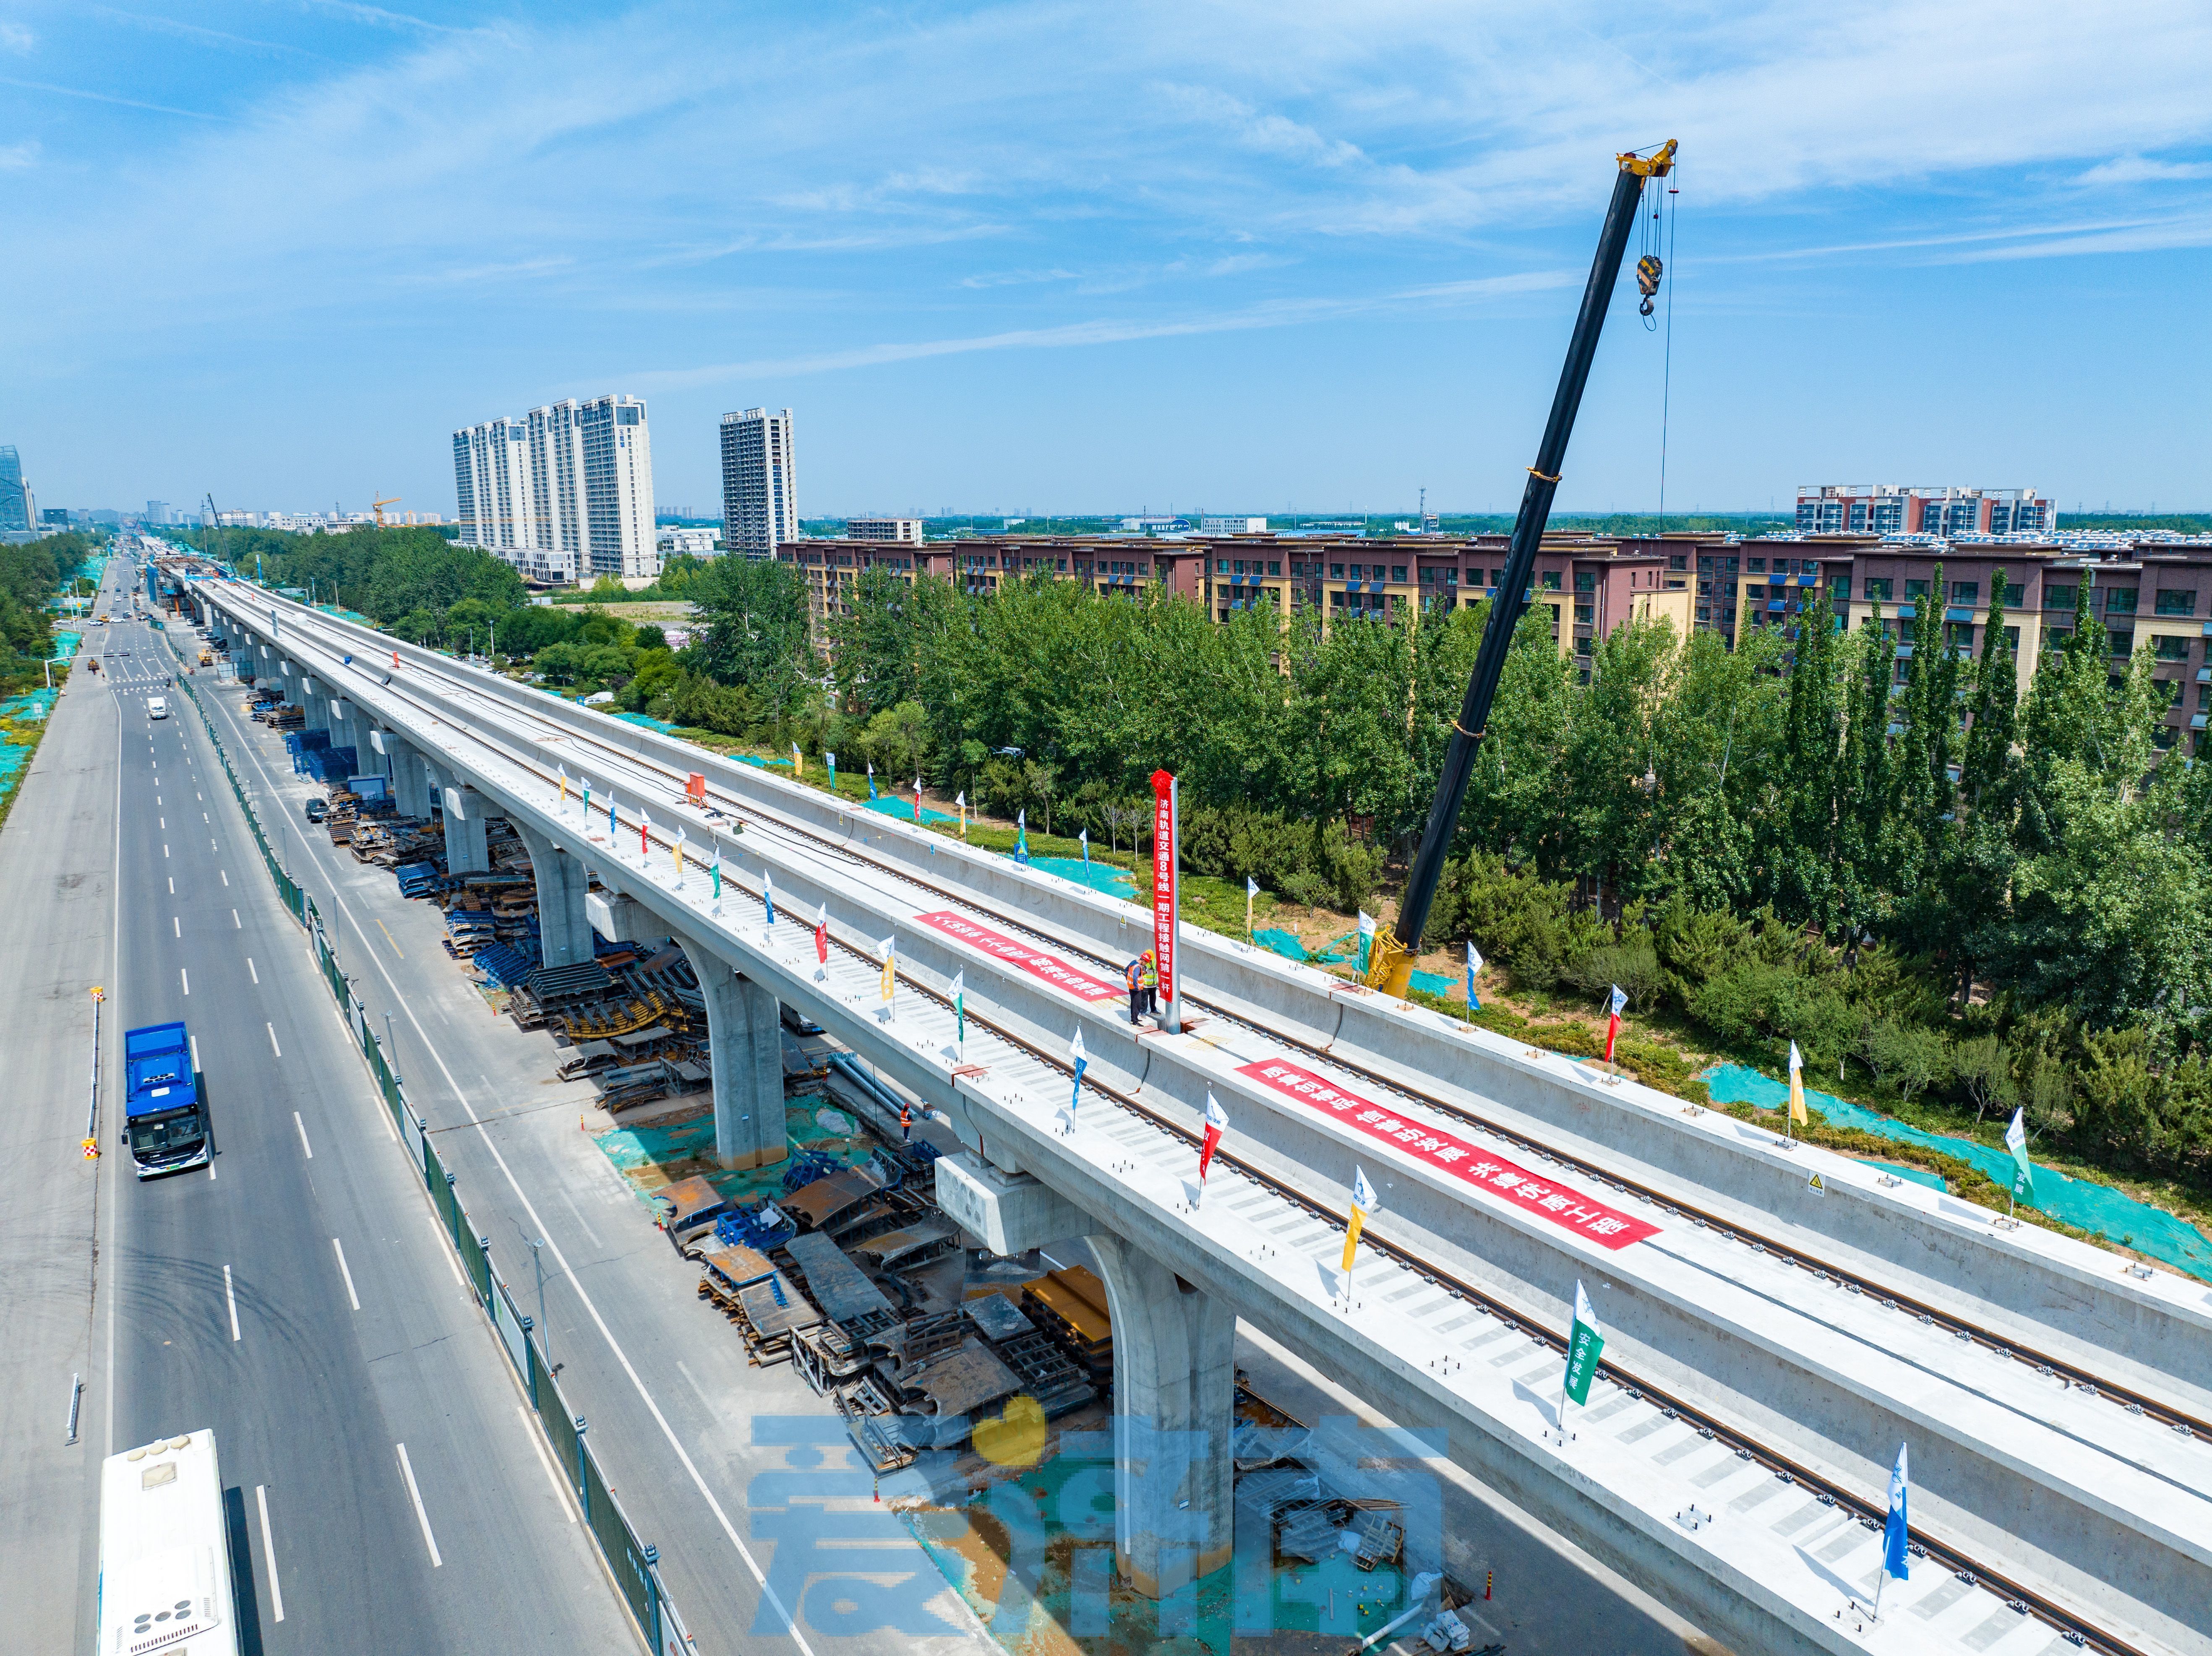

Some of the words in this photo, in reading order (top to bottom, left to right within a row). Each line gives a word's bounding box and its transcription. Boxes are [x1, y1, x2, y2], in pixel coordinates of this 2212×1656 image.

[933, 916, 985, 938] 人人讲安全
[1030, 958, 1111, 997] 畅通生命通道
[1158, 799, 1170, 993] 济南轨道交通8号线一期工程接触网第一杆
[1260, 1066, 1359, 1111] 质量创精品
[1355, 1110, 1469, 1163] 信誉助发展
[1468, 1162, 1631, 1235] 共建优质工程
[1568, 1332, 1591, 1390] 安全发展
